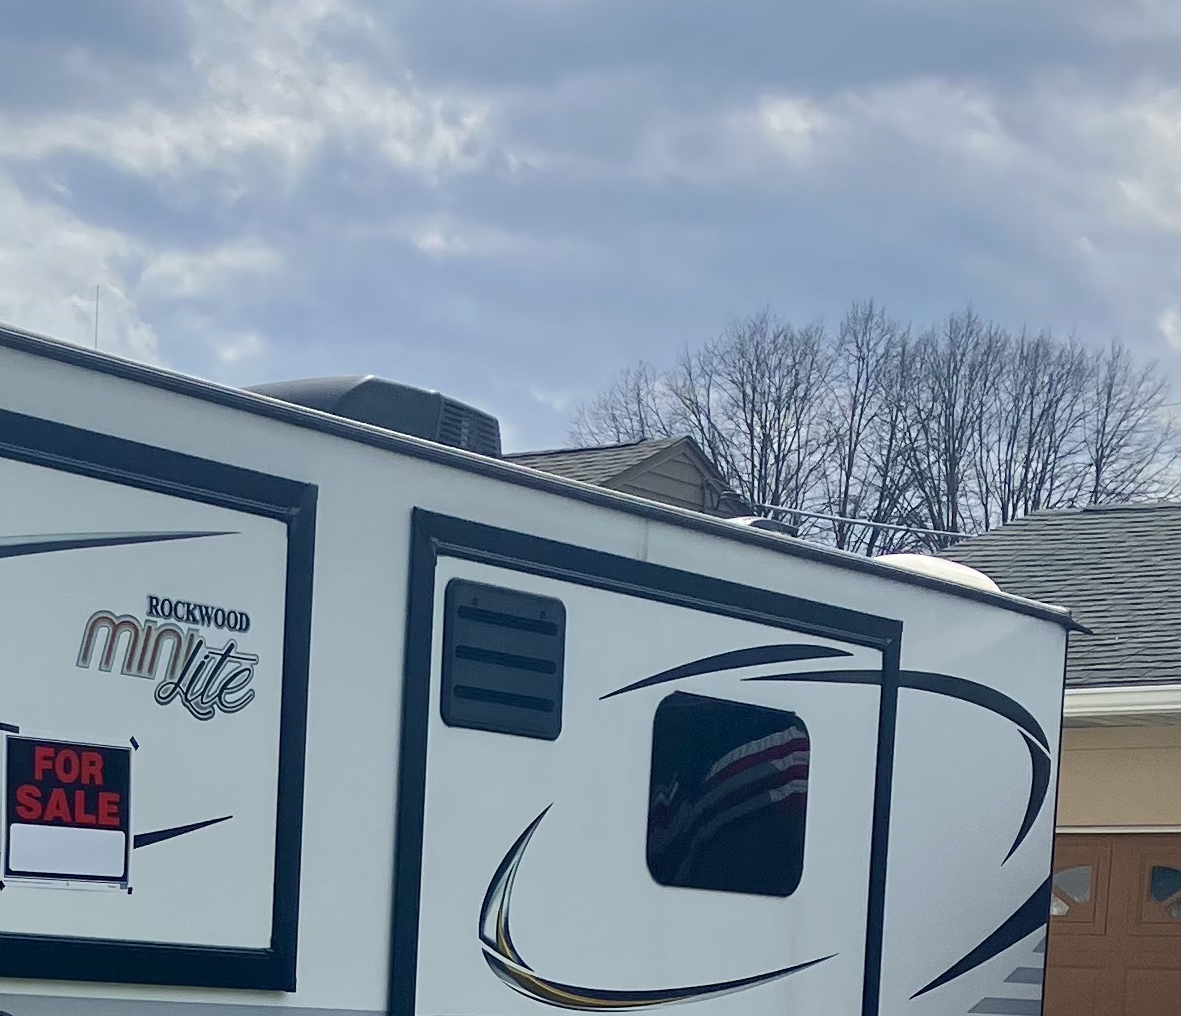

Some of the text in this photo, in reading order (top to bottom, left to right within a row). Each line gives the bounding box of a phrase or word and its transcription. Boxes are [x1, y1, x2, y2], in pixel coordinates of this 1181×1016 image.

[146, 594, 251, 633] ROCKWOOD
[34, 745, 104, 786] FOR
[15, 784, 121, 826] SALE
